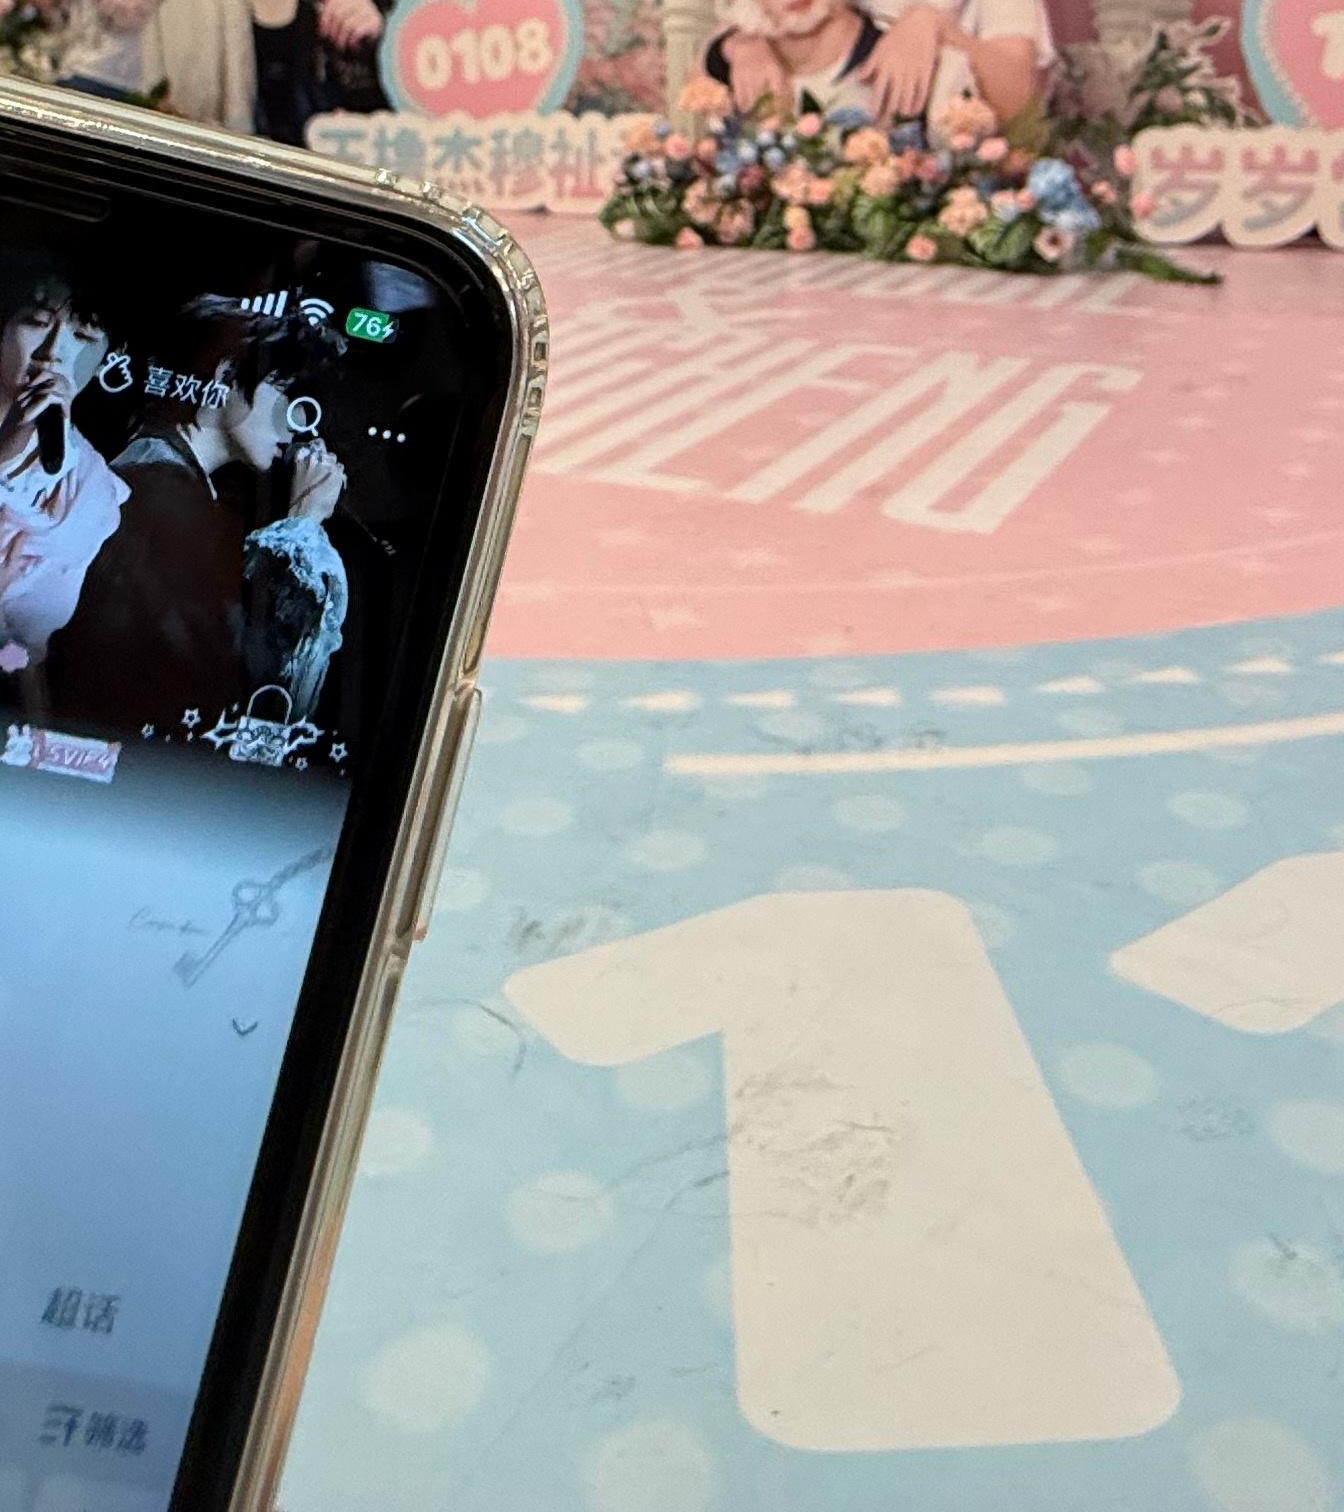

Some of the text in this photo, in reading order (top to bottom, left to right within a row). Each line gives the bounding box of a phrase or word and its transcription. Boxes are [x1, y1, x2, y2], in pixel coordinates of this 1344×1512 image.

[416, 18, 552, 91] 0108
[354, 312, 381, 338] 76
[143, 360, 231, 411] 喜欢你
[39, 1286, 122, 1336] 超话
